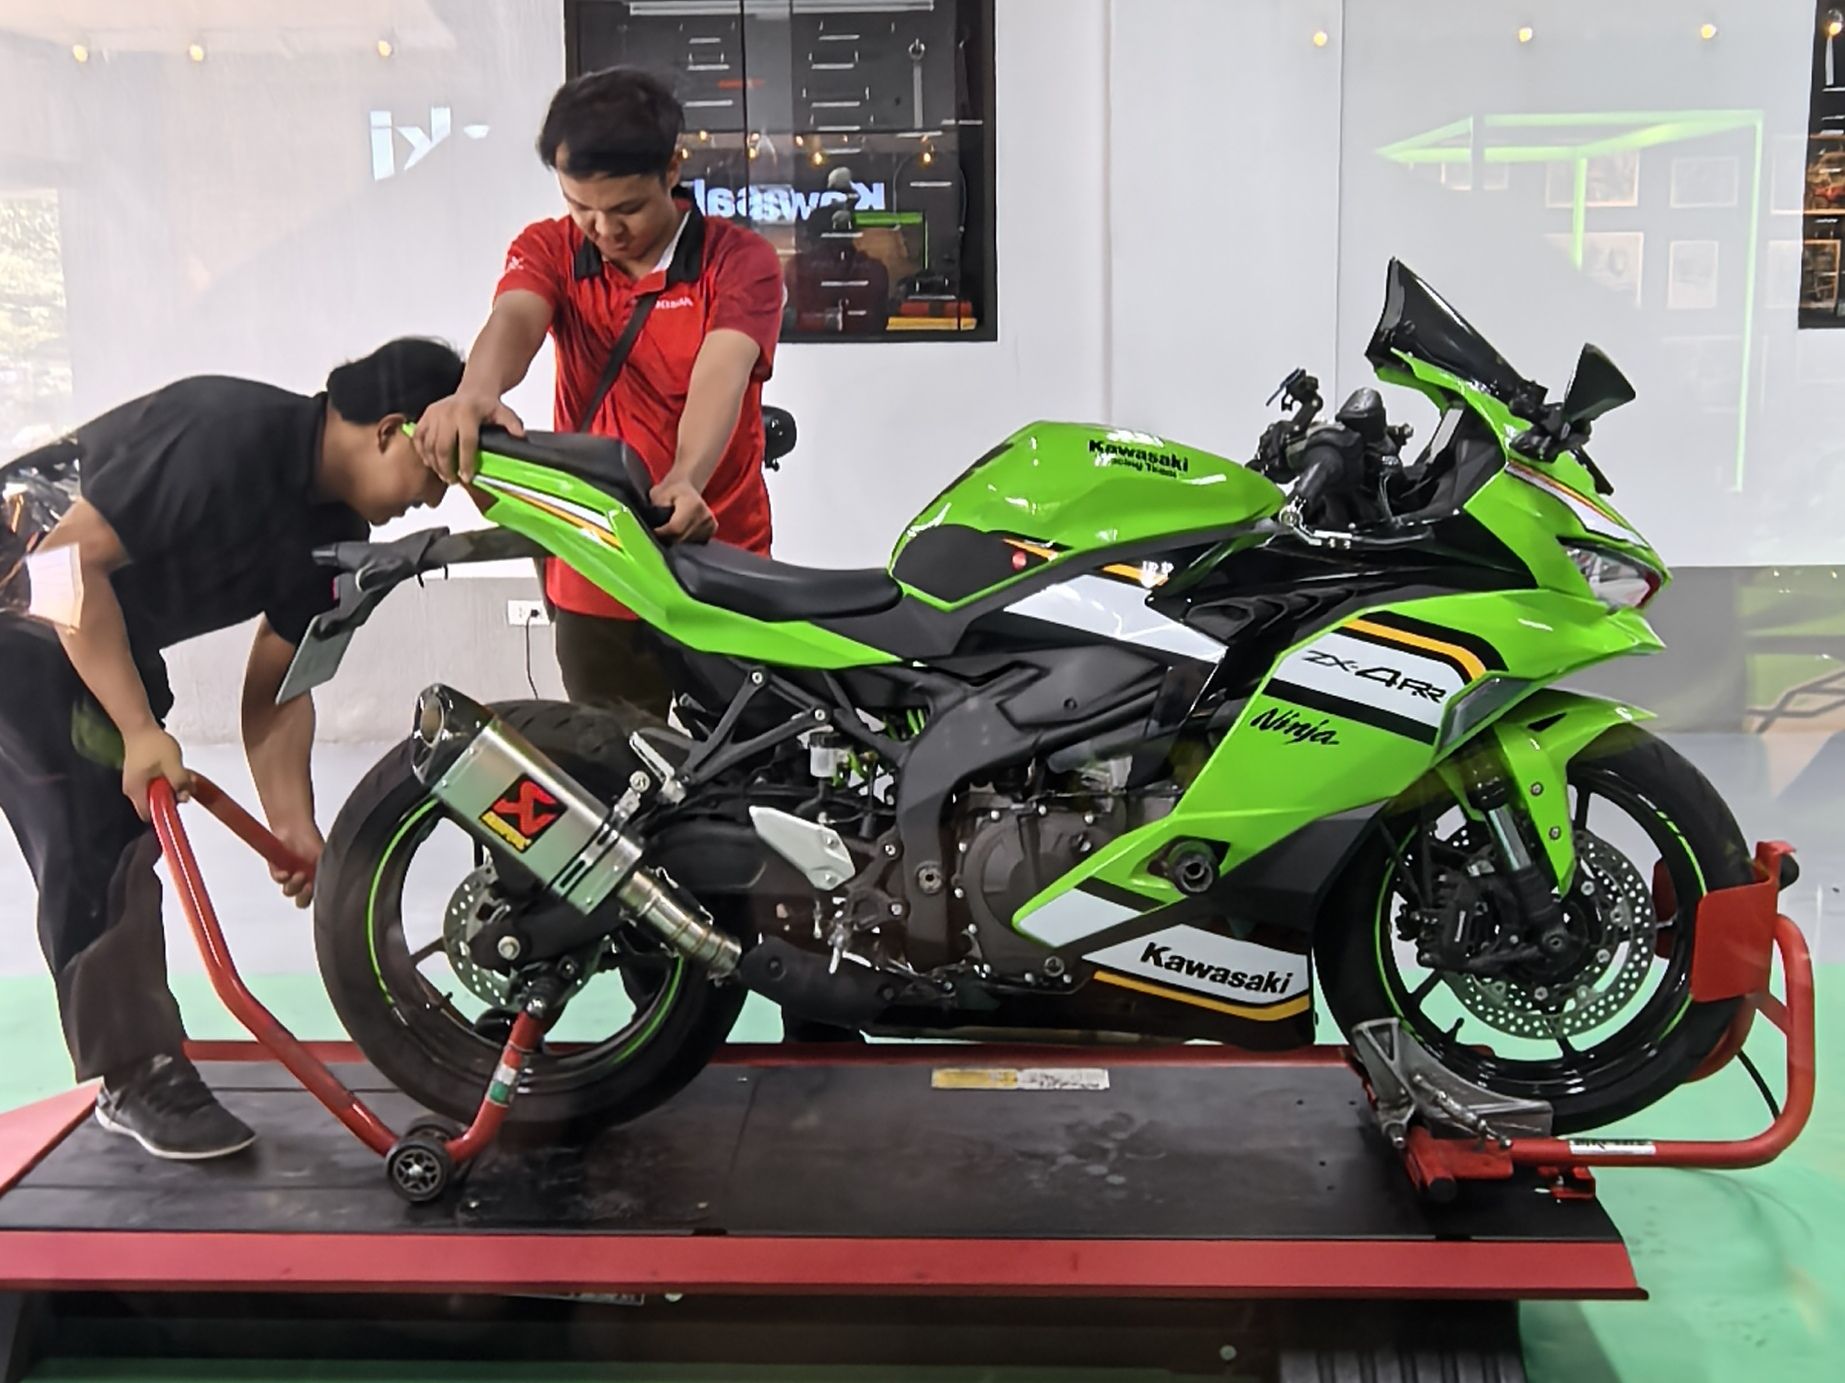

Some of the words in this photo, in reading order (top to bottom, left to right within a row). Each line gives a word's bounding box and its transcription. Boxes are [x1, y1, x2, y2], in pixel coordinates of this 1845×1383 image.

[1089, 439, 1189, 473] Kawasaki
[1302, 649, 1447, 704] ZX-4RR
[1250, 707, 1340, 745] Ninja
[1139, 941, 1294, 994] Kawasaki
